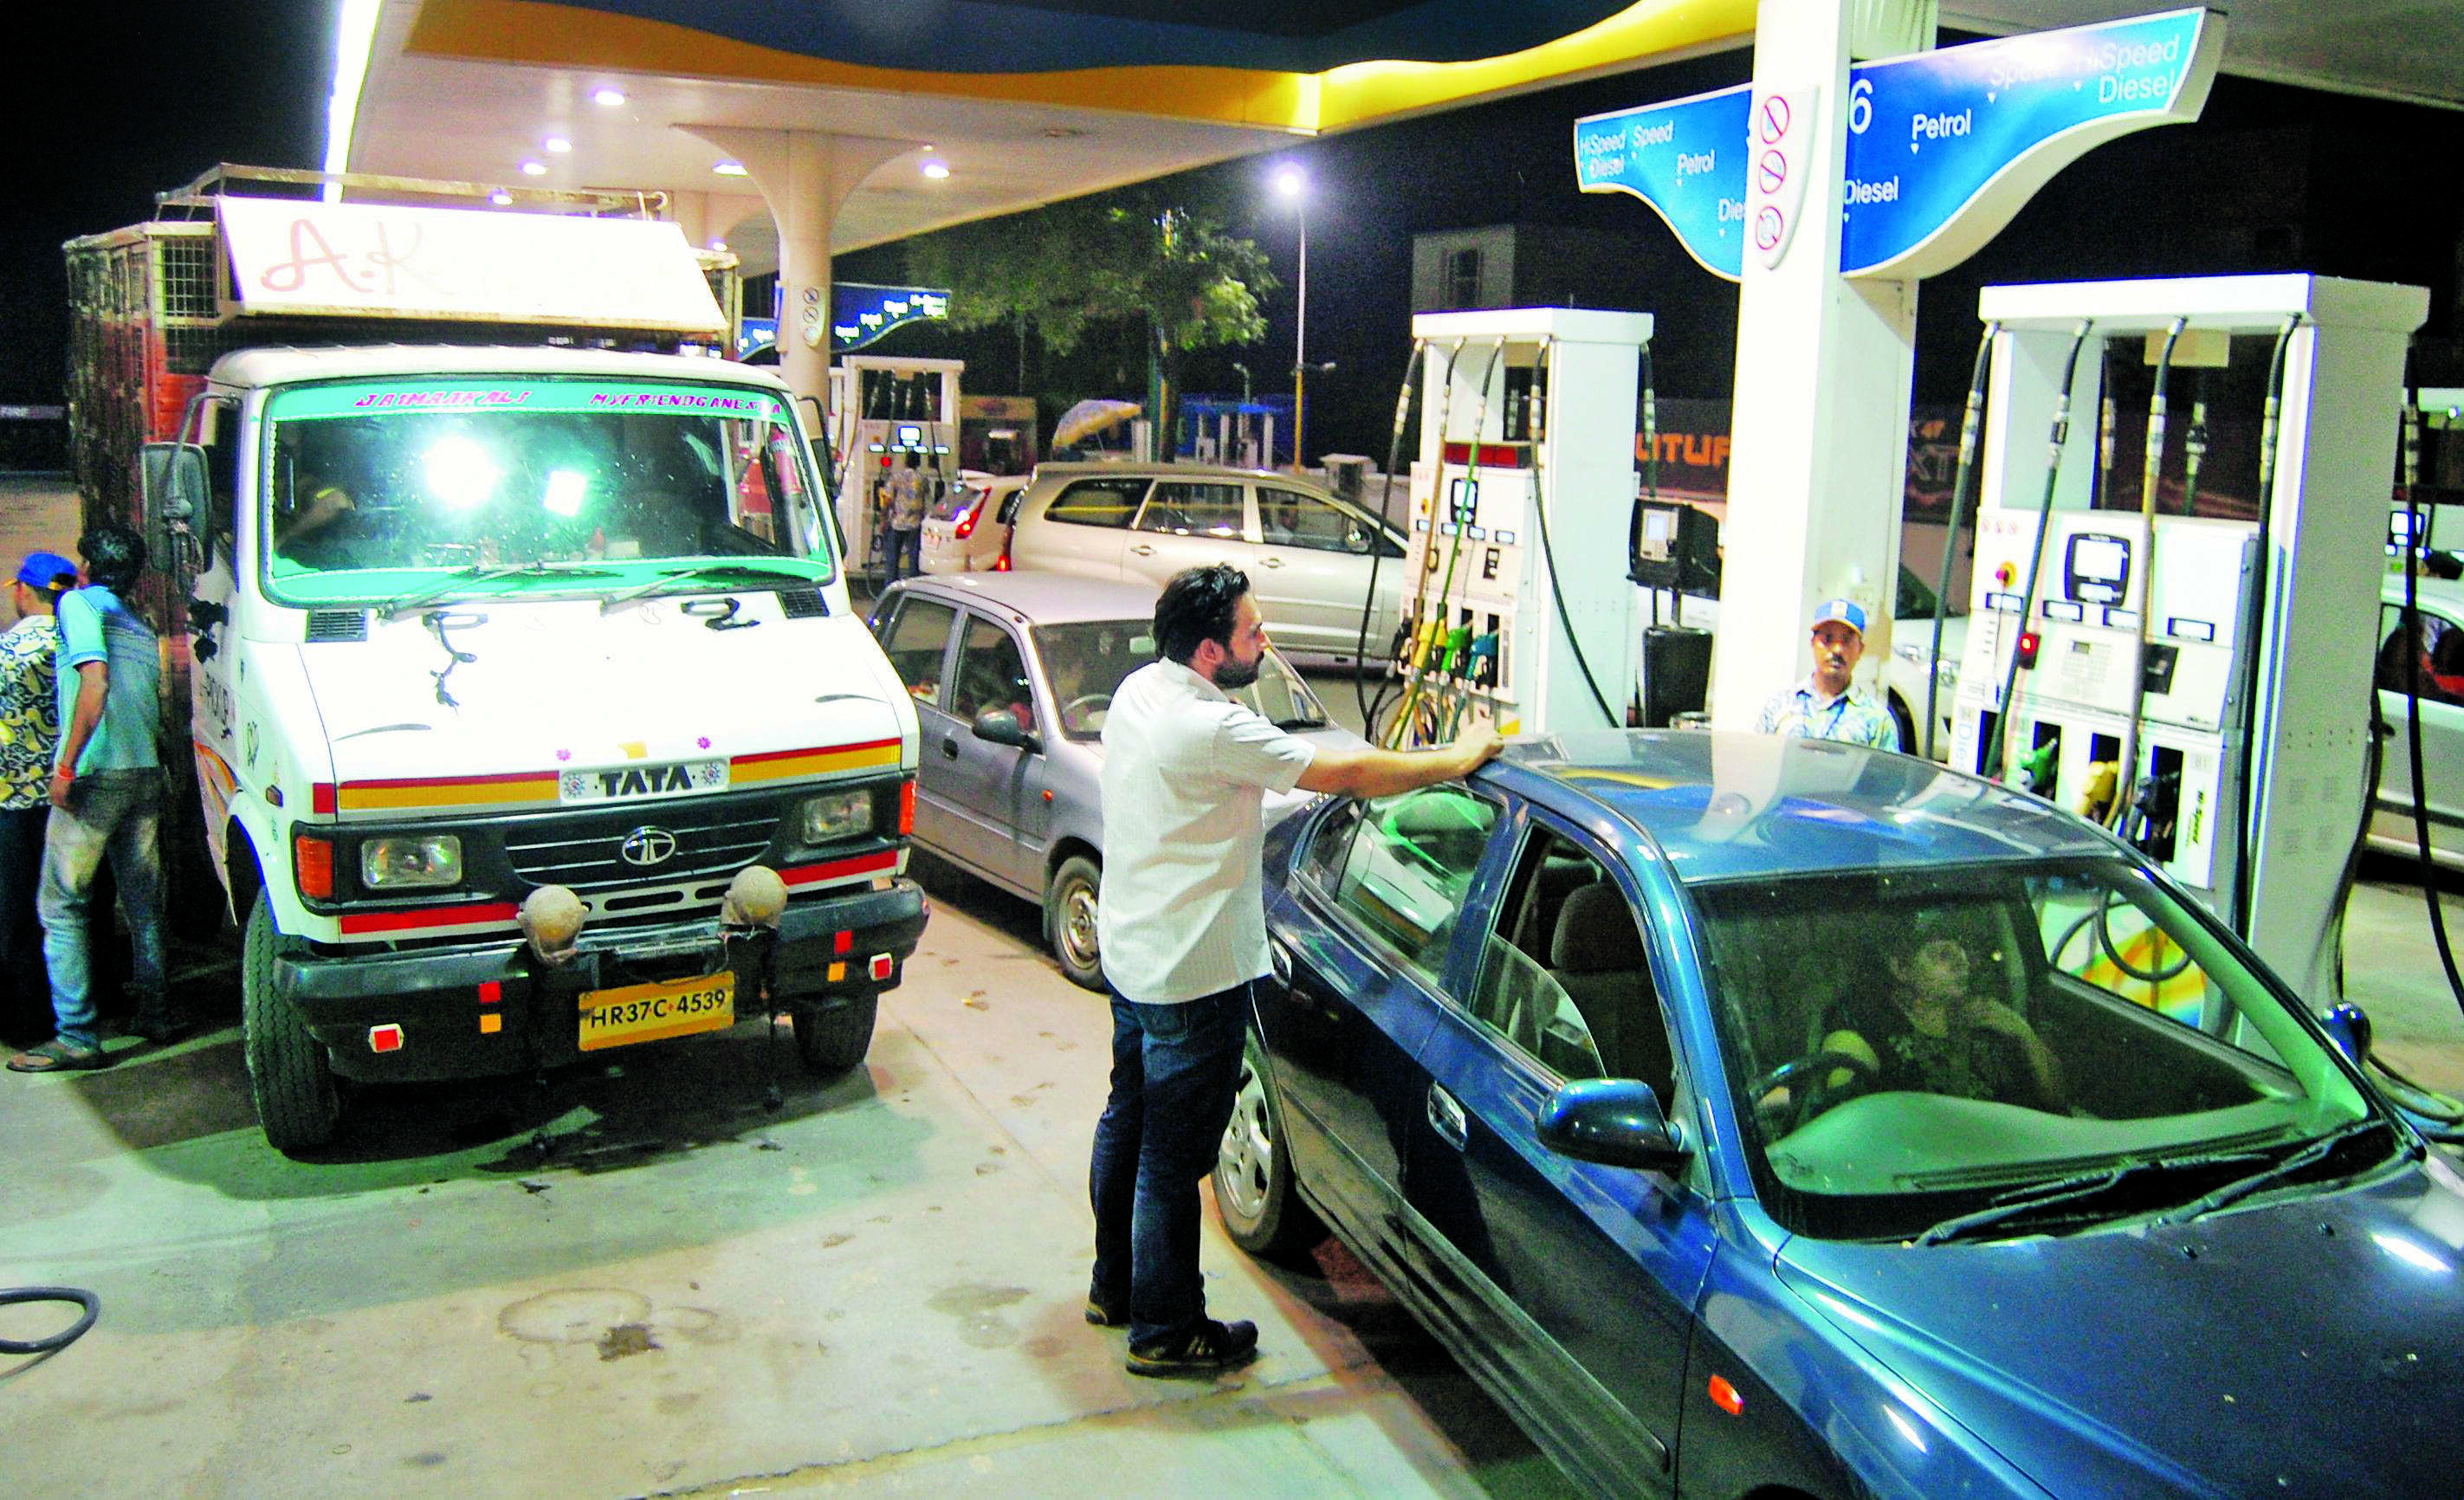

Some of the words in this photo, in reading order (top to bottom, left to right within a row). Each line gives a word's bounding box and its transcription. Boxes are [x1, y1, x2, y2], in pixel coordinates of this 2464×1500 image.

[2099, 68, 2175, 103] Diesel
[1849, 79, 1872, 134] 6
[1633, 120, 1673, 146] Speed
[1912, 108, 1971, 140] Petrol
[1589, 154, 1625, 178] Diesel
[1677, 149, 1716, 176] Petrol
[1844, 175, 1898, 204] Diesel
[1718, 197, 1746, 222] Die
[598, 765, 693, 797] TATA
[591, 999, 668, 1028] HR37C
[676, 988, 726, 1013] 4539
